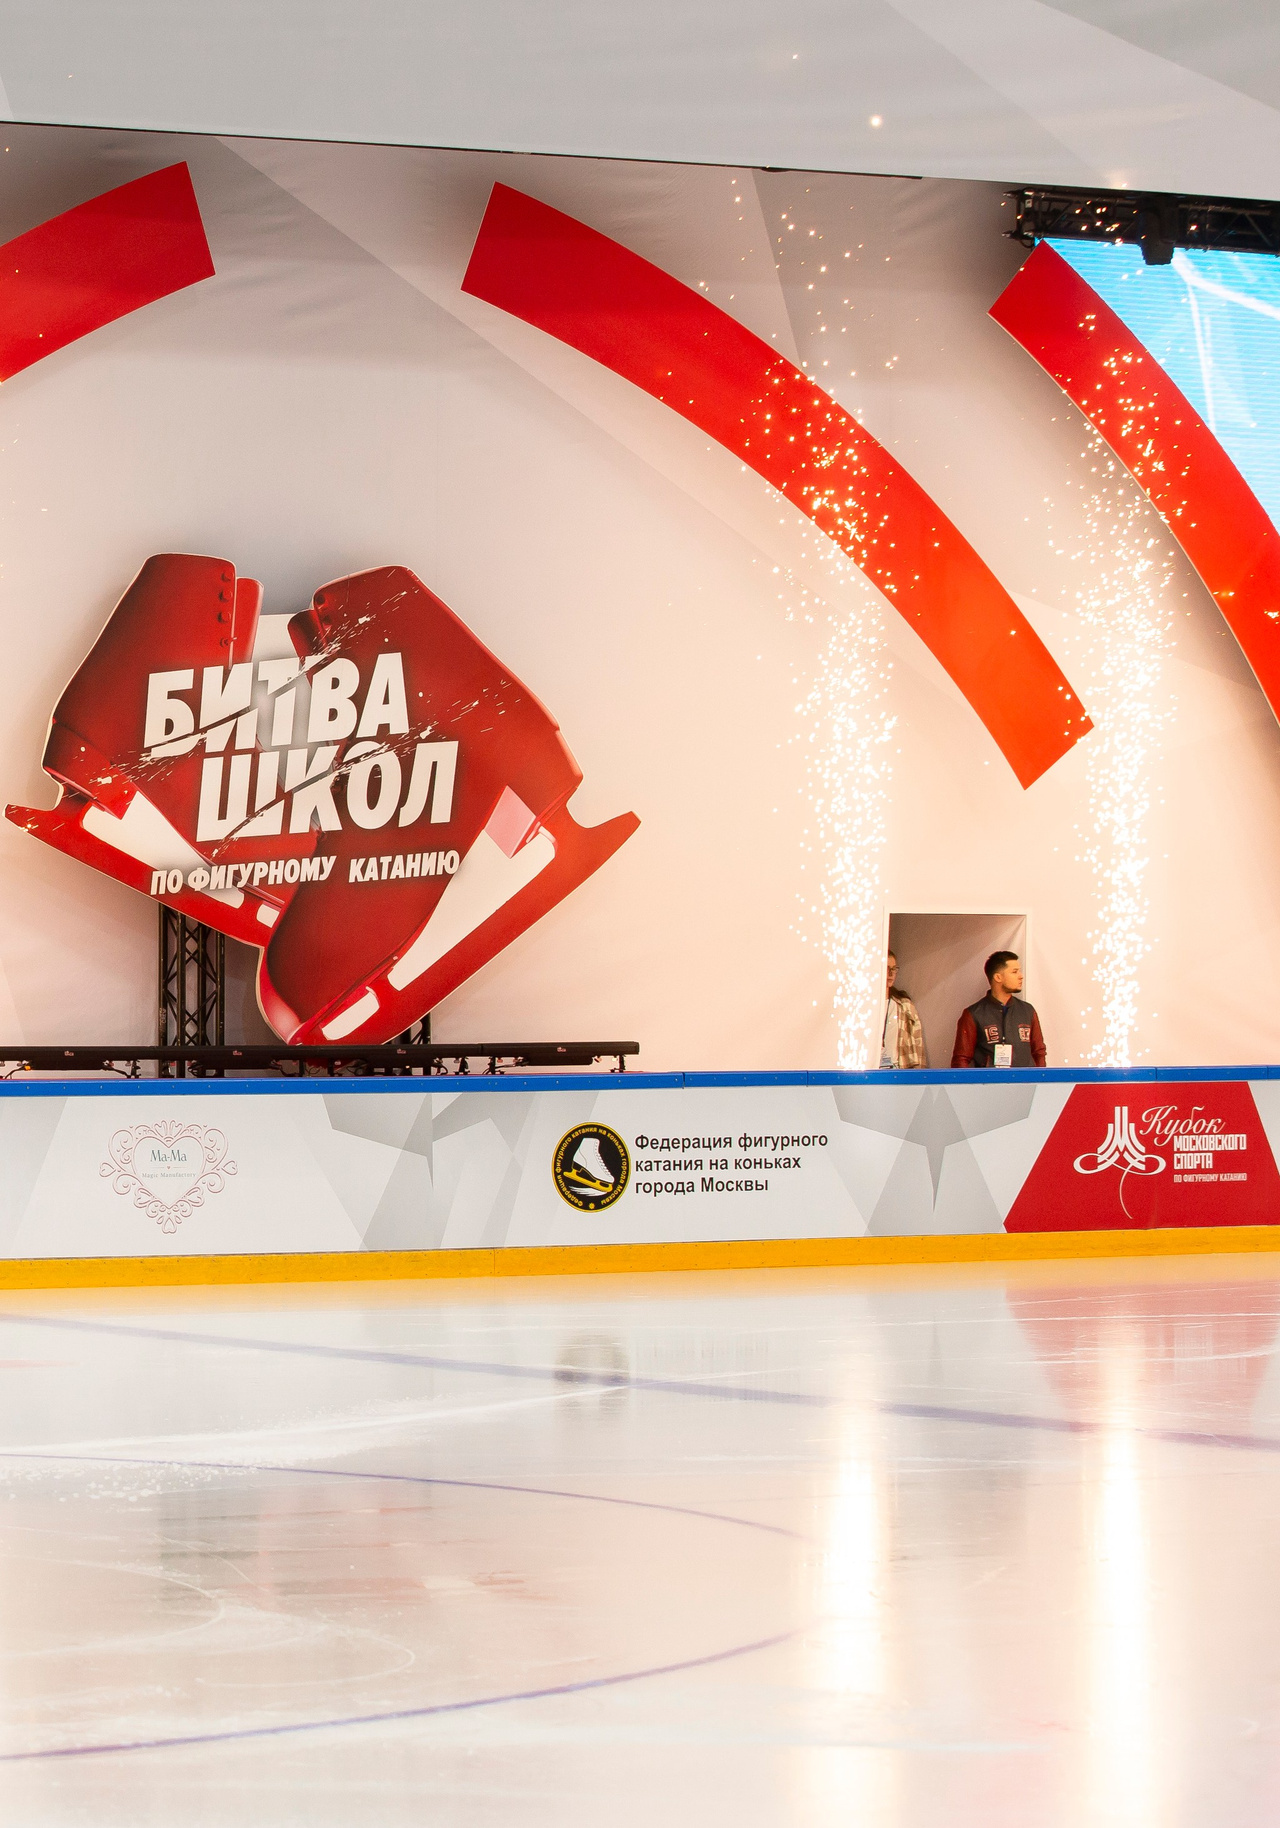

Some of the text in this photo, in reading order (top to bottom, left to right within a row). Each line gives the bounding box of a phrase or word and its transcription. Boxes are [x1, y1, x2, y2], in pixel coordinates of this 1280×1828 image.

[143, 652, 409, 759] БИТВА
[195, 740, 460, 842] ШКОЛ
[150, 850, 461, 895] ПО ФИГУРНОМУ КАТАНИЮ
[1139, 1105, 1226, 1147] Кубок
[635, 1133, 828, 1152] Федерация фигурного
[1173, 1134, 1247, 1151] МОСКОВСКОГО
[635, 1154, 801, 1171] катания на коньках
[1173, 1153, 1213, 1169] СПОРТА
[635, 1176, 768, 1197] города Москвы
[1173, 1173, 1248, 1183] ПО ФИГУРНОМУ КАТАНИЮ
